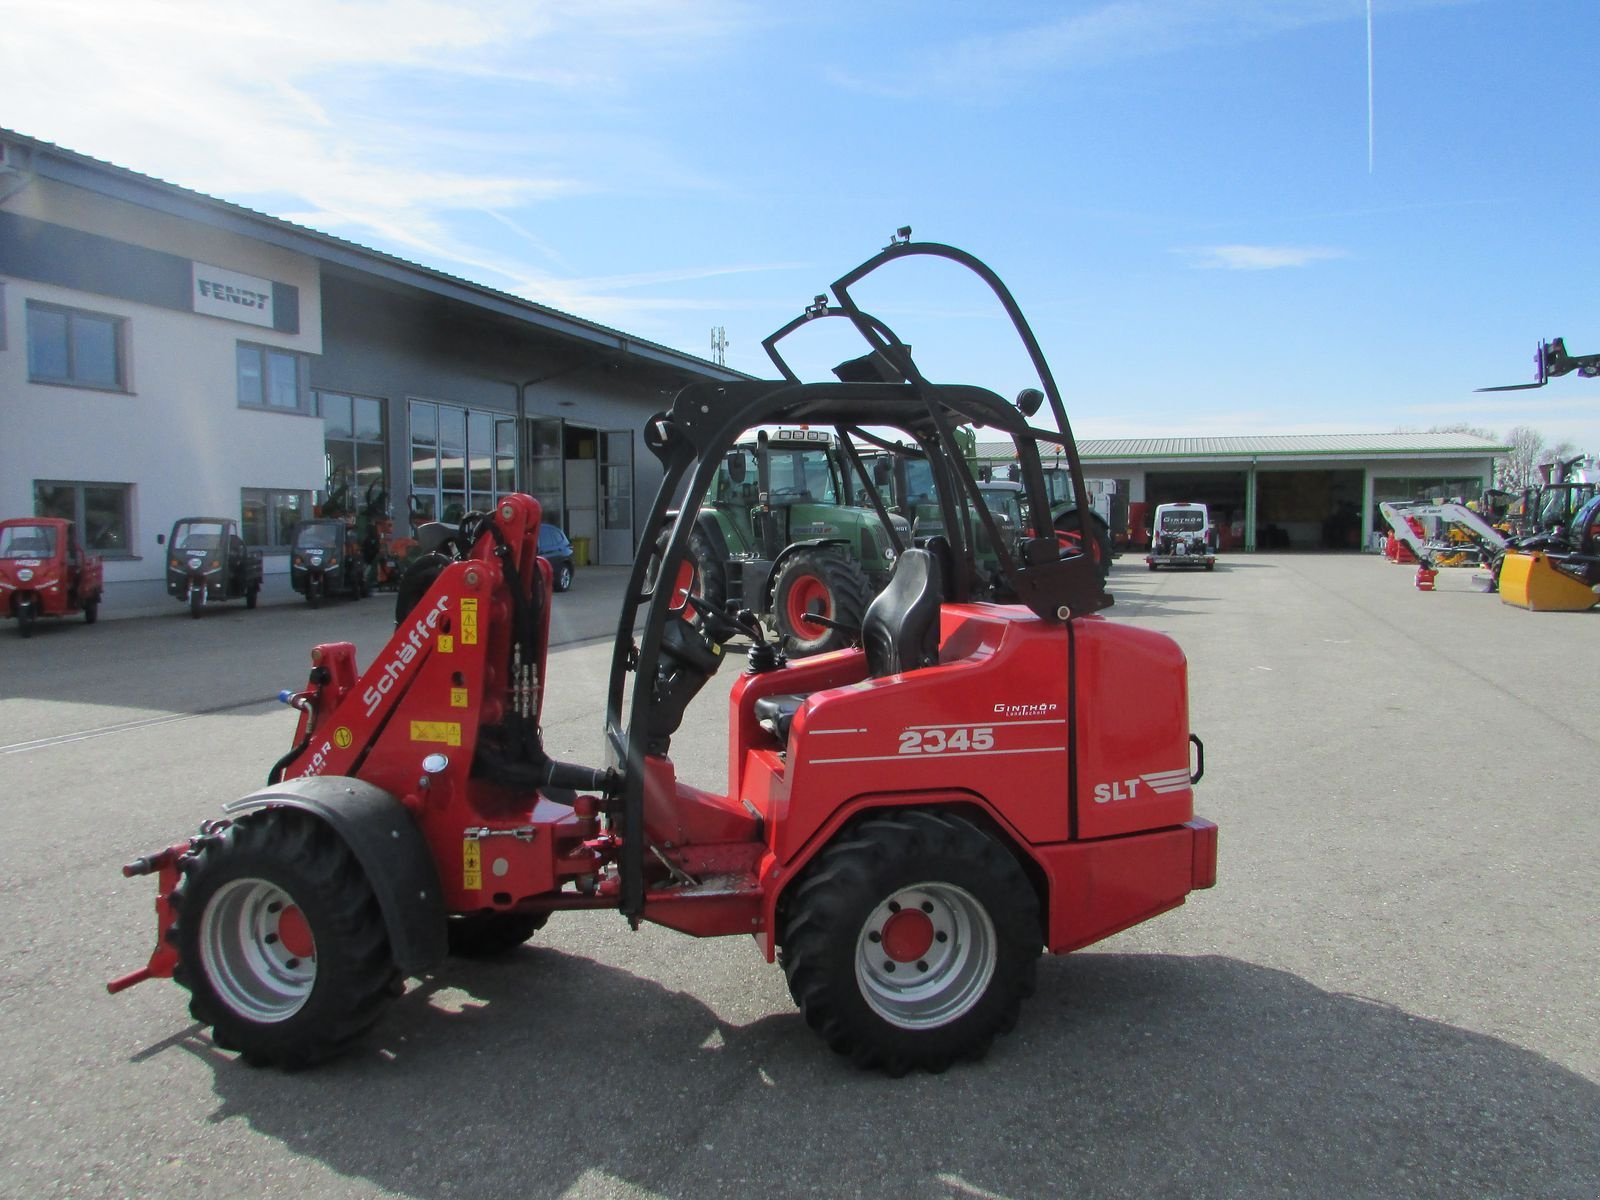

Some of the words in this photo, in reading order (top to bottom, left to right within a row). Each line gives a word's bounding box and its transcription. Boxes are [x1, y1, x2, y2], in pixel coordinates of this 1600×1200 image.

[198, 279, 270, 310] FENDT
[363, 595, 449, 718] Schäffer
[898, 728, 995, 754] 2345
[1093, 778, 1140, 804] SLT
